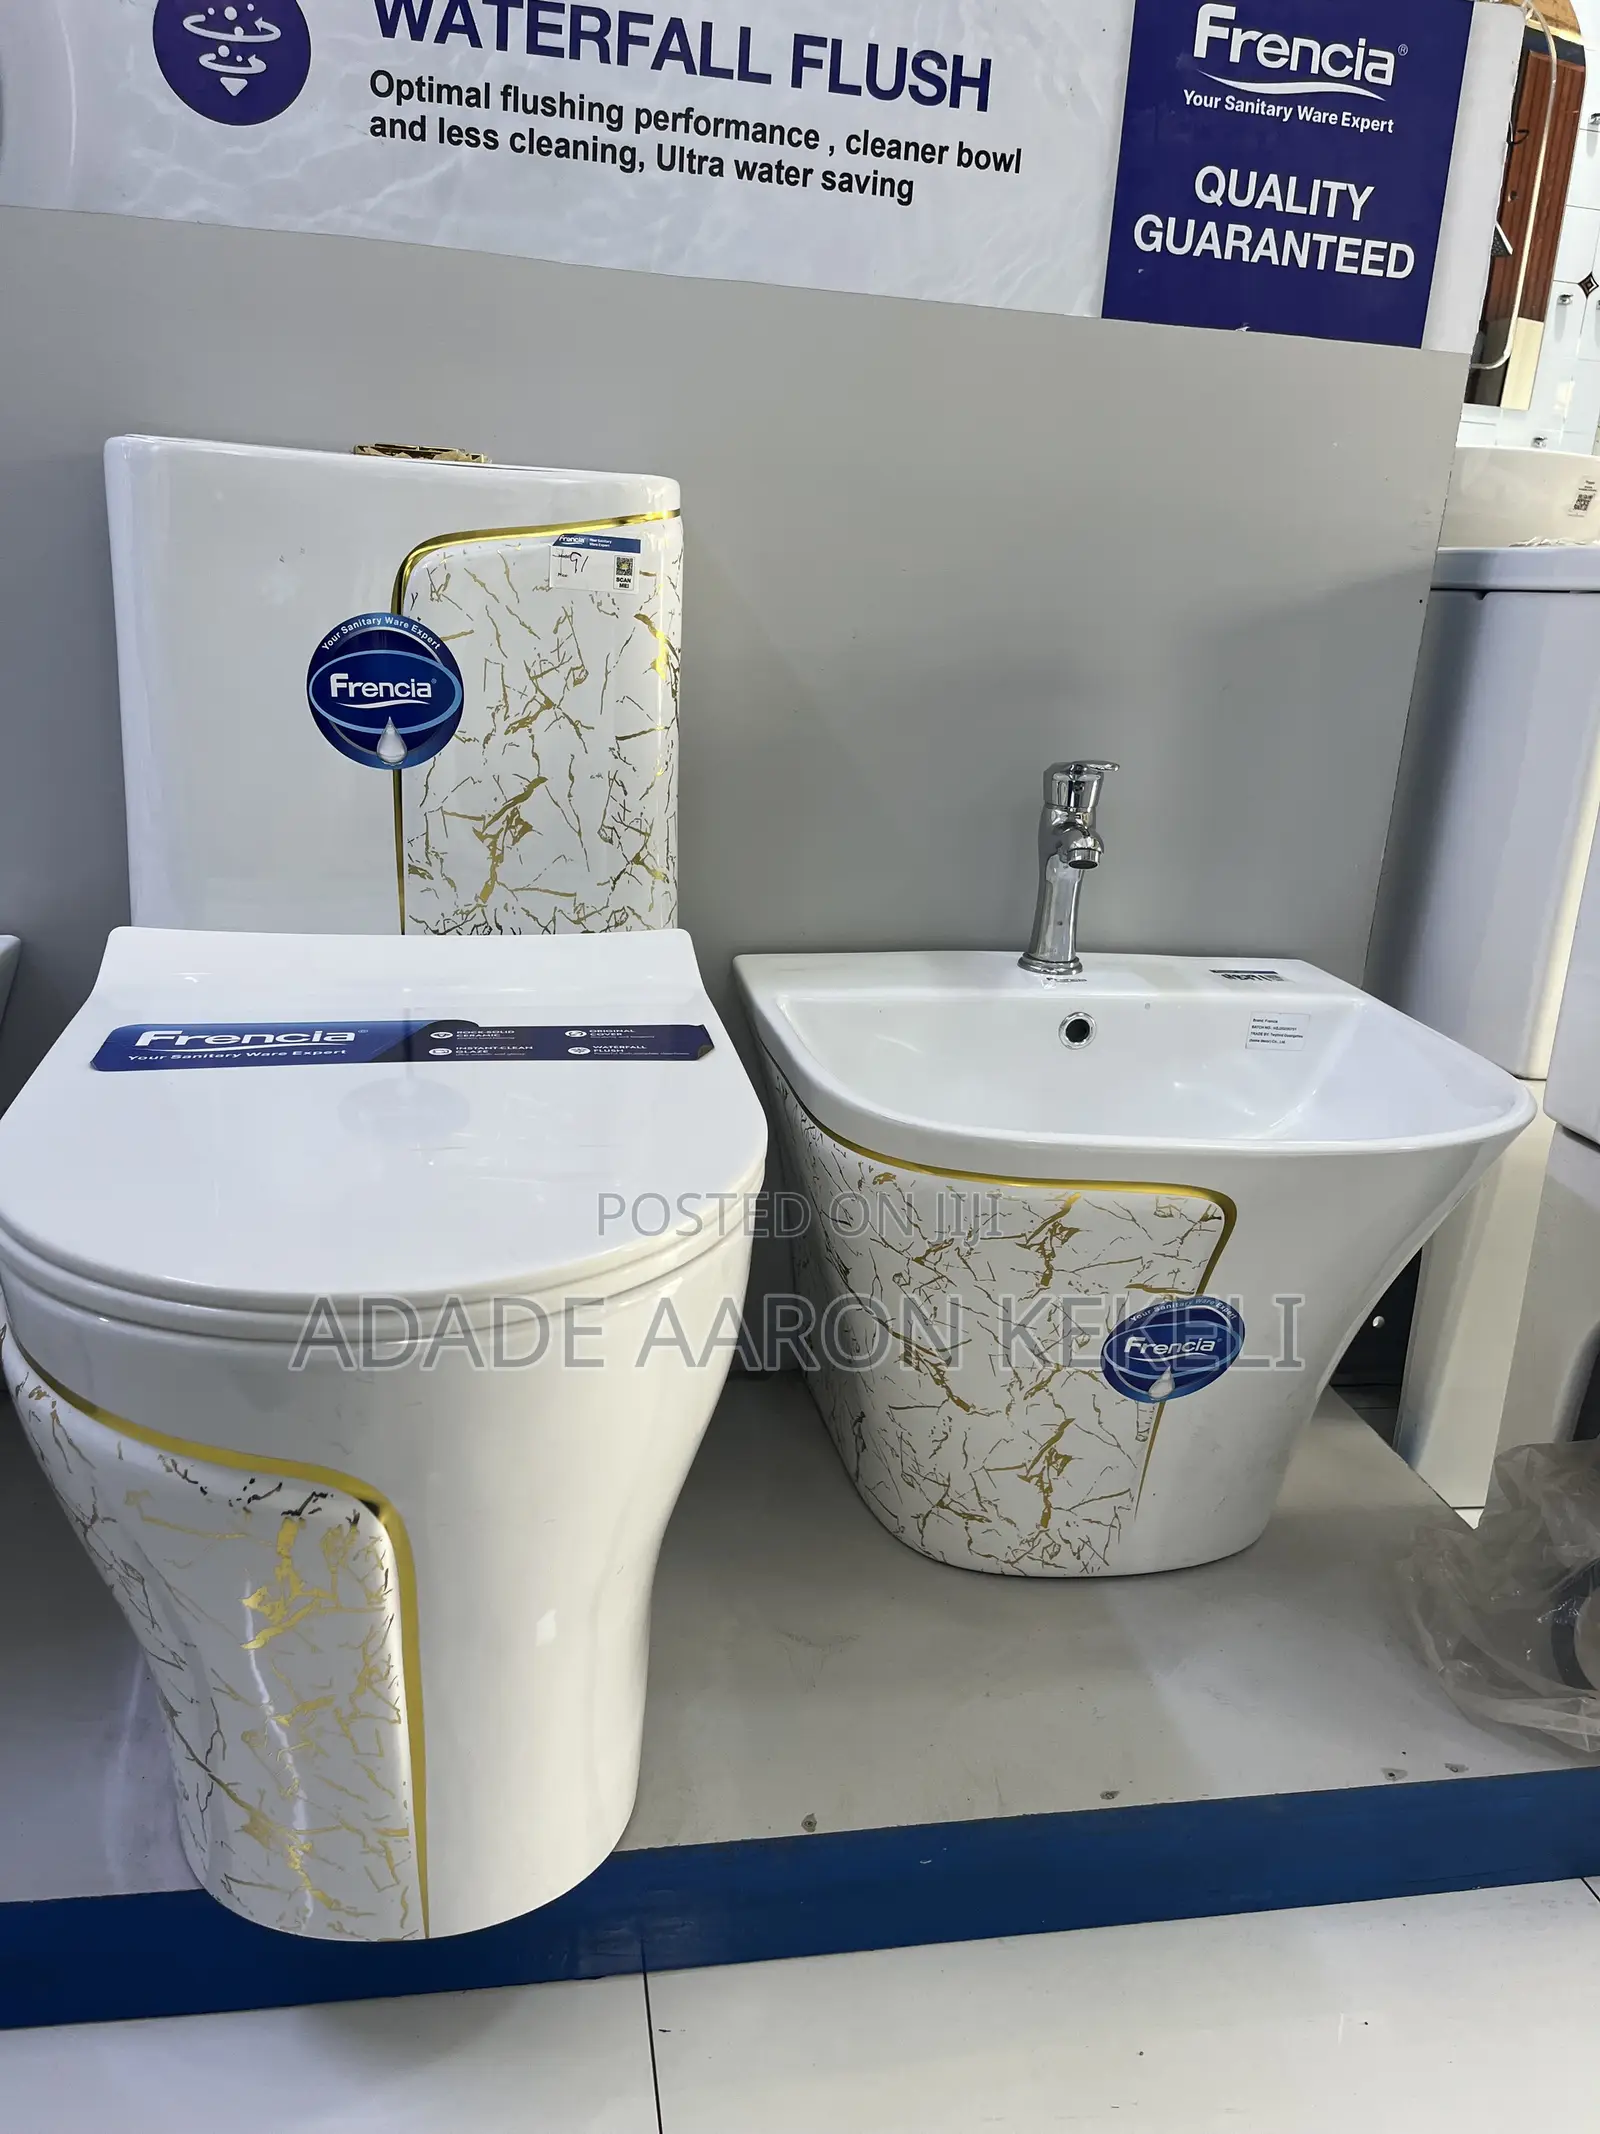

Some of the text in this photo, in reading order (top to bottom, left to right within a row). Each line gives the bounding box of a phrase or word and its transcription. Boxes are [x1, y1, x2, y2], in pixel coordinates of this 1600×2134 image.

[373, 0, 992, 113] WATERFALL FLUSH
[1193, 4, 1396, 86] Frencia
[369, 69, 491, 109] Optimal
[501, 84, 624, 132] flushing
[634, 105, 821, 151] performance
[845, 130, 950, 166] cleaner
[956, 142, 1022, 175] bowl
[1183, 89, 1394, 134] Your Sanitary Ware Expert
[369, 115, 914, 206] and less cleaning, Ultra water saving
[1194, 165, 1375, 222] QUALITY
[1133, 214, 1415, 280] GUARANTEED
[321, 616, 441, 650] Your Sanitary Ware Expert
[330, 673, 432, 698] Frencia
[135, 1030, 356, 1047] Frencia
[171, 1052, 242, 1061] Sanitary
[292, 1049, 347, 1057] Expert
[1130, 1309, 1152, 1322] Your
[1153, 1301, 1193, 1313] Sanitary
[1215, 1302, 1238, 1320] Expert
[1124, 1336, 1217, 1355] Frencia
